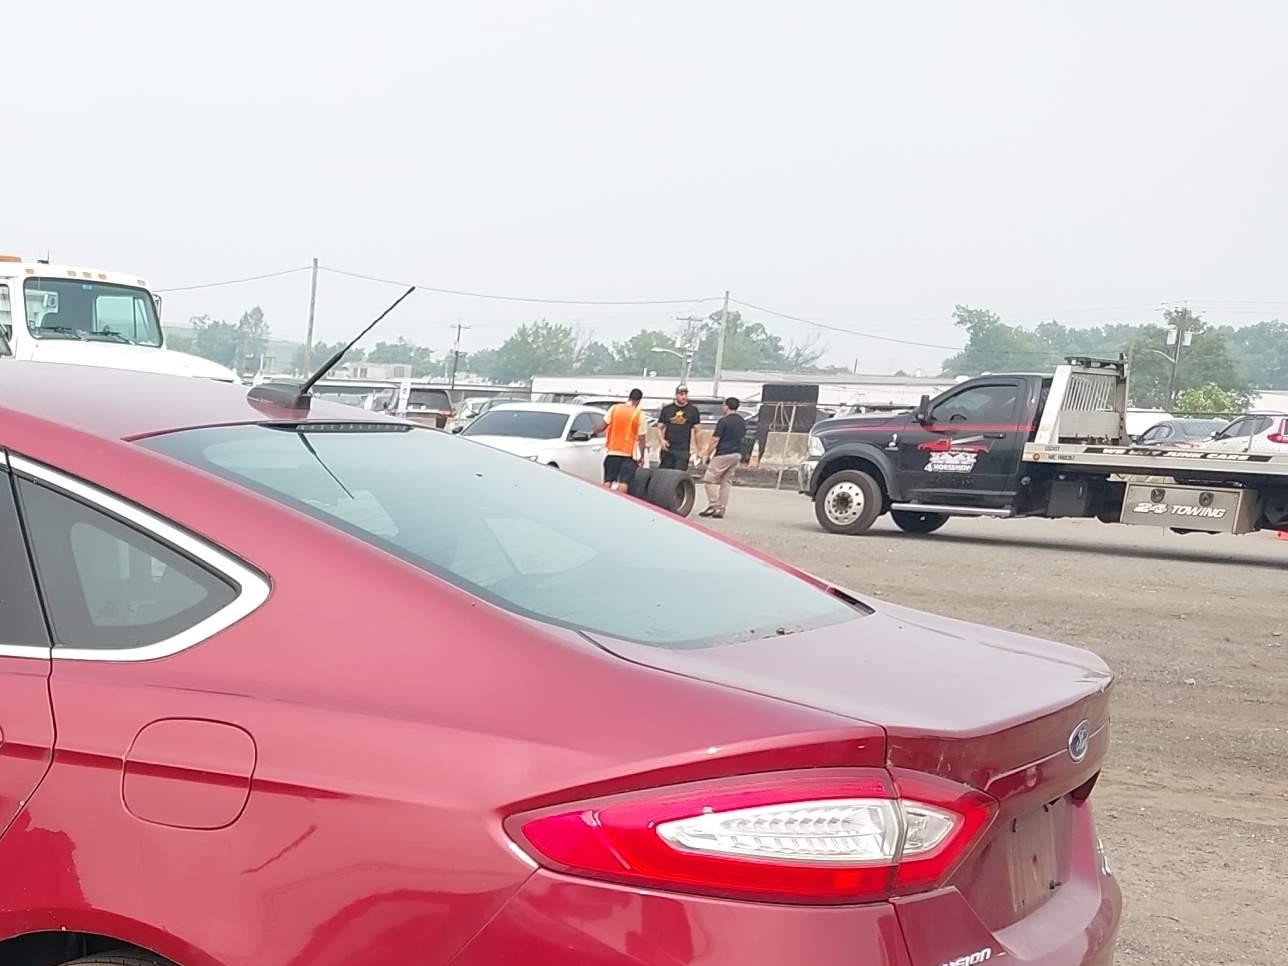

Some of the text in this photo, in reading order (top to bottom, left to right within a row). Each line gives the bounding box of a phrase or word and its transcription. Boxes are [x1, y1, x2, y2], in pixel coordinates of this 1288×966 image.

[1206, 453, 1251, 461] CARS
[1133, 502, 1226, 519] 24 TOWING
